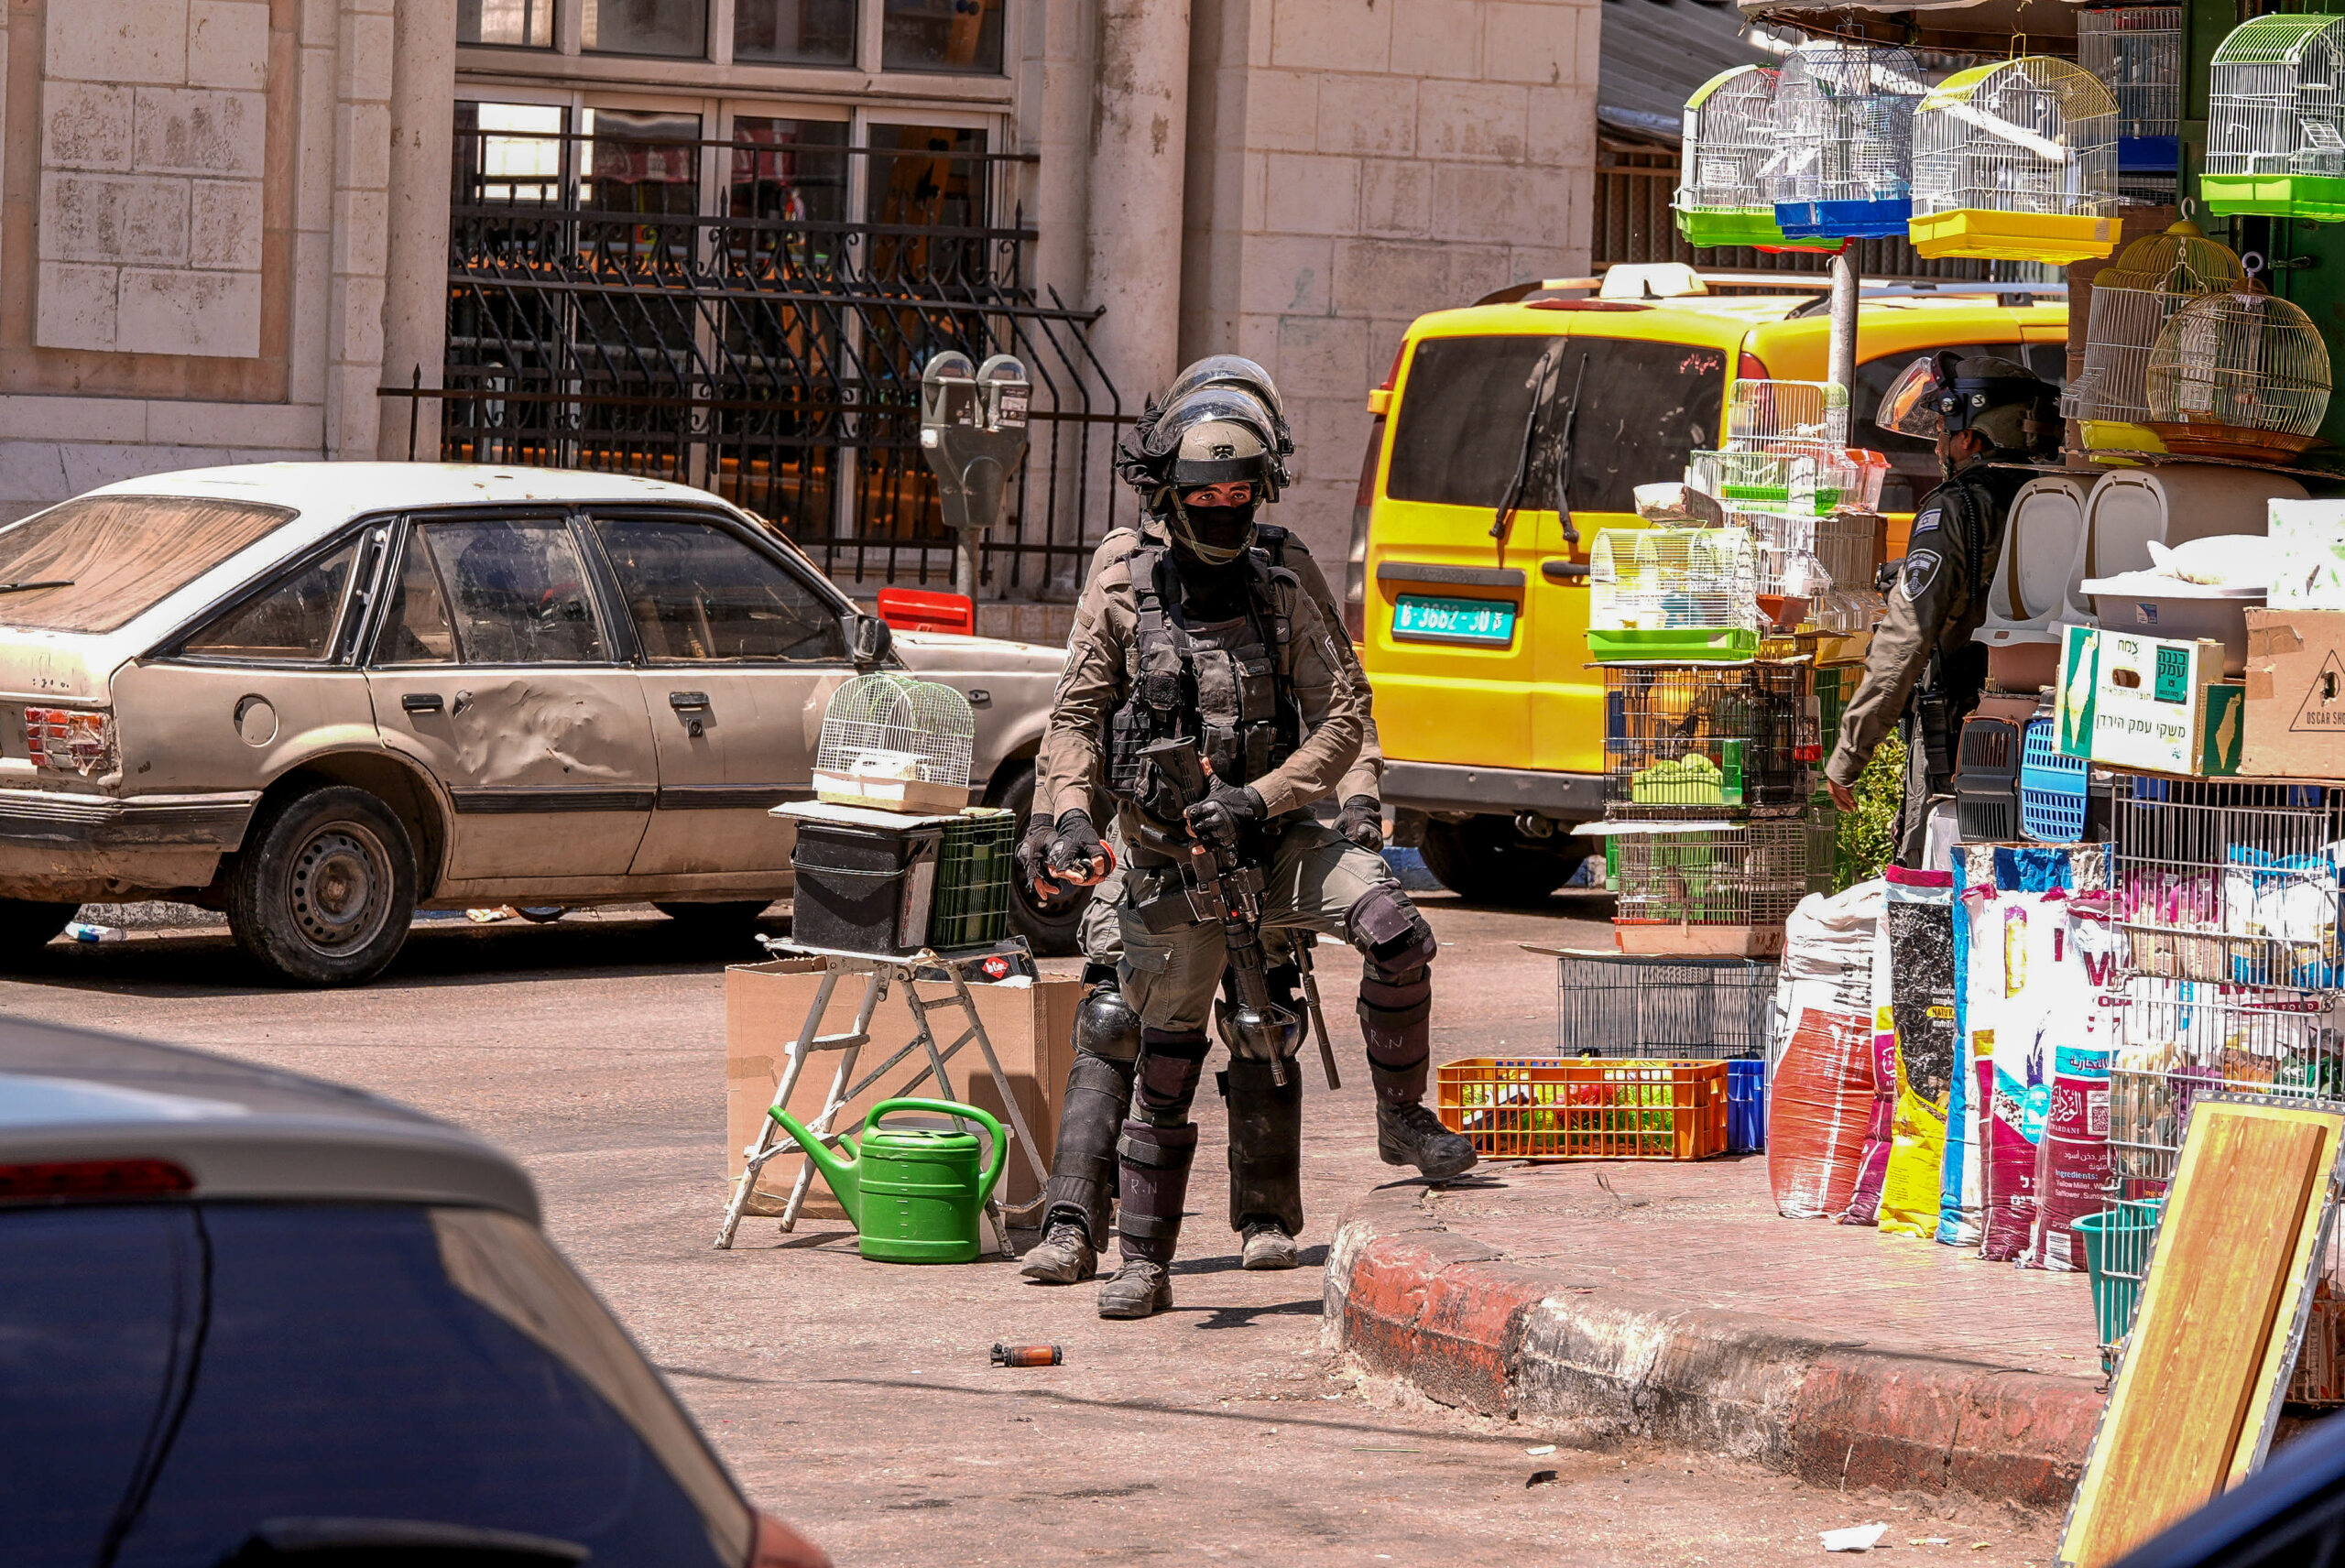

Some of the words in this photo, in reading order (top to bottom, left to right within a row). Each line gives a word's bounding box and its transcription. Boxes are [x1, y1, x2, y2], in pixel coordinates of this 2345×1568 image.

[2119, 639, 2138, 655] צמח
[2157, 650, 2187, 666] בננה
[2157, 663, 2186, 679] עמק
[2096, 713, 2124, 730] הירדן
[2307, 712, 2331, 724] OSCAR
[2128, 718, 2153, 735] עמק
[2156, 723, 2186, 738] משקי
[2055, 1169, 2098, 1180] Ingredients:
